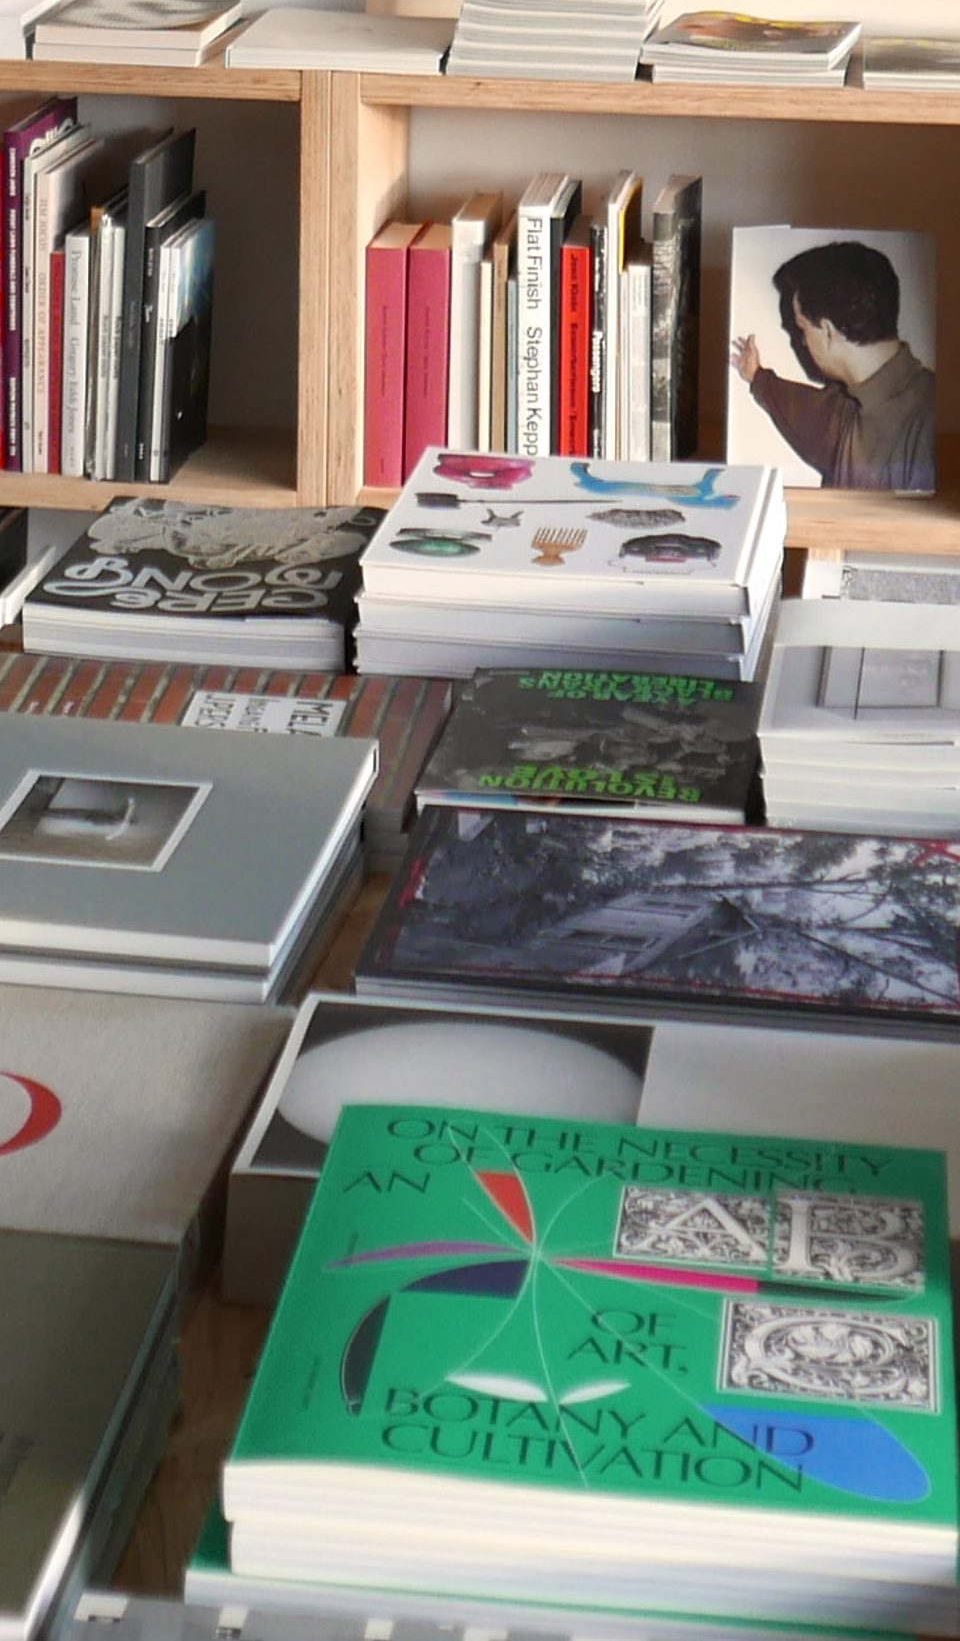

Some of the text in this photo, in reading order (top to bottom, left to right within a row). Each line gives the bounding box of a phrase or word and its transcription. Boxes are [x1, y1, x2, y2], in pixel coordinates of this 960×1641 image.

[37, 199, 48, 216] JIM
[527, 218, 543, 251] Flat
[68, 250, 82, 293] Promise
[527, 255, 543, 309] Finish
[569, 253, 579, 280] Jens
[37, 272, 48, 309] ORDER
[37, 312, 47, 325] OF
[71, 296, 82, 326] Land
[37, 329, 48, 395] APPEARANCE
[67, 337, 81, 378] Gregory
[524, 326, 543, 404] Stephan
[590, 331, 604, 393] Passengers
[66, 406, 80, 433] Jones
[477, 774, 702, 805] REVOLUTION
[514, 764, 677, 787] IS LOVE
[387, 1116, 894, 1177] ON THE NECESSITY
[413, 1142, 497, 1167] OF
[344, 1170, 431, 1195] AN
[592, 1308, 677, 1337] OF
[384, 1387, 816, 1459] BOTANY AND
[381, 1423, 805, 1493] CULTIVATION
